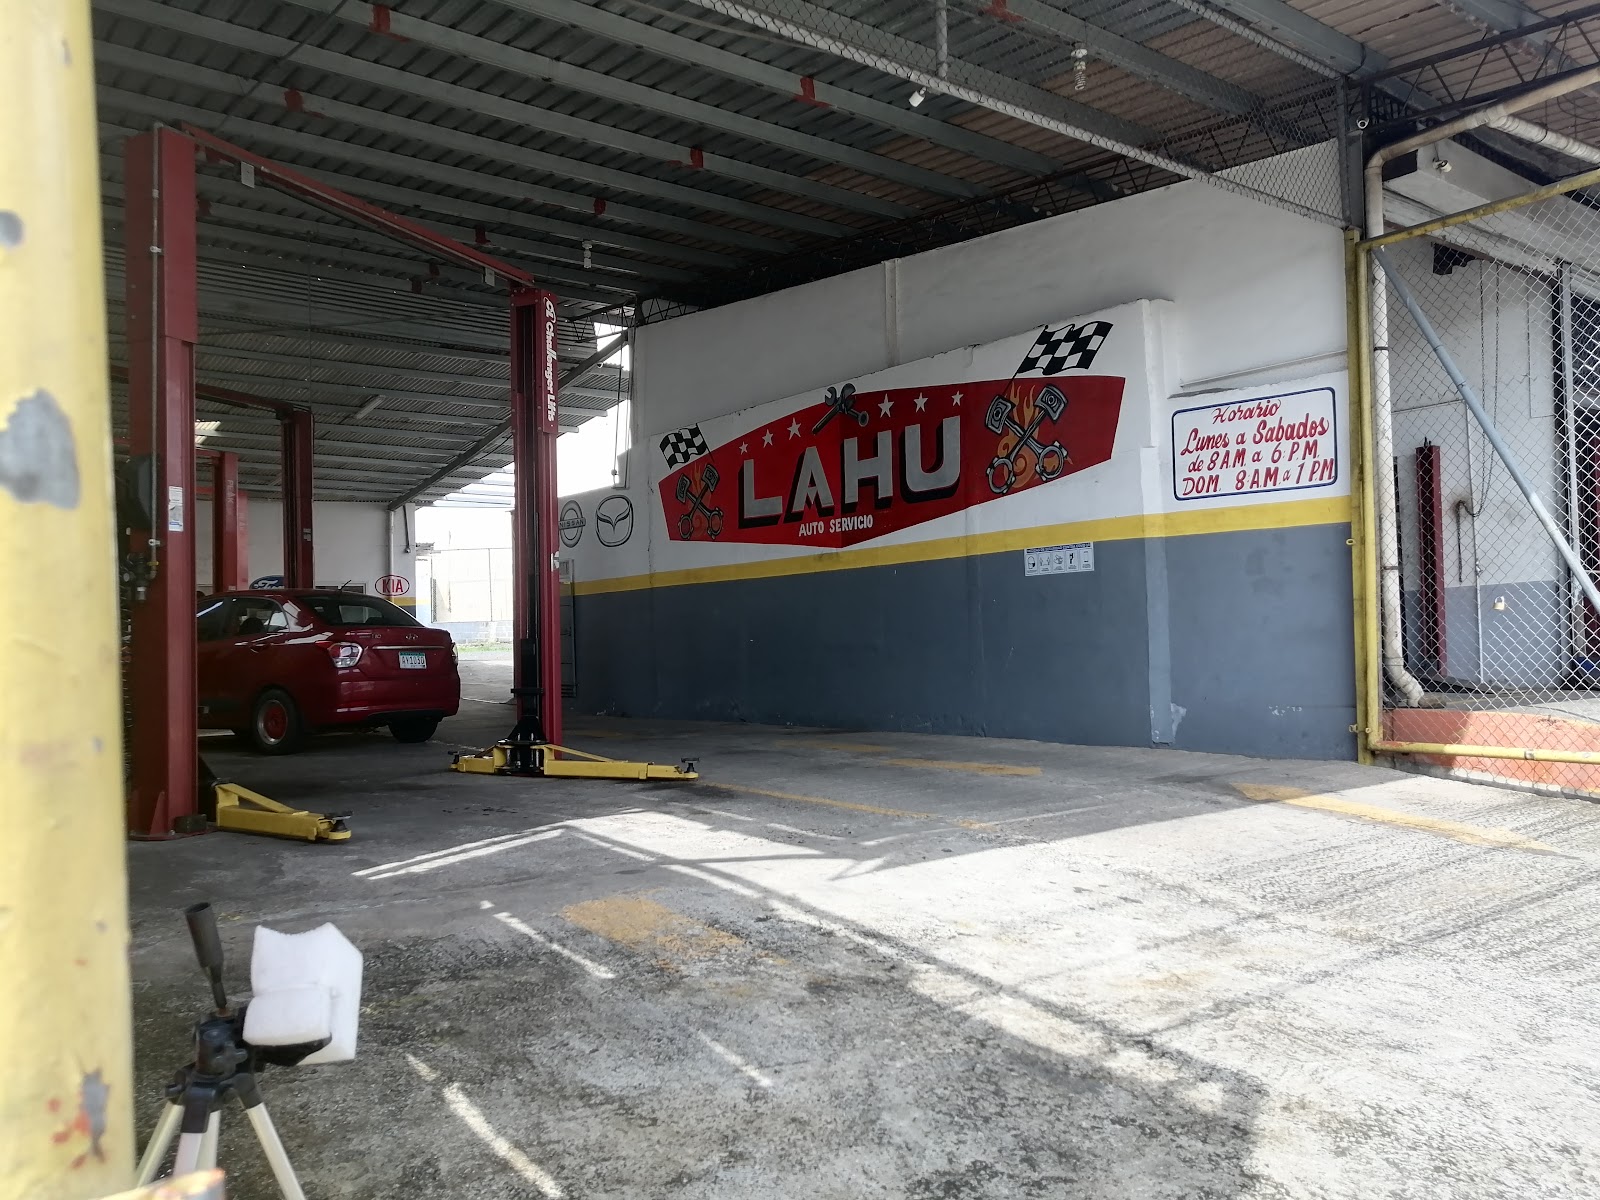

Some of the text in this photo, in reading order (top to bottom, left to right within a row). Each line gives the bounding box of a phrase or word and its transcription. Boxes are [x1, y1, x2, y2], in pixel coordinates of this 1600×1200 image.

[545, 322, 557, 394] Challenger
[547, 394, 557, 421] Lifts
[1211, 399, 1282, 424] Horario
[1180, 413, 1330, 456] Lunes a Sabados
[741, 415, 962, 524] LAHU
[1187, 455, 1204, 473] de
[1251, 449, 1264, 463] a
[1282, 468, 1292, 482] a
[226, 479, 236, 503] PEAK
[560, 519, 584, 528] NISSAN
[799, 514, 874, 537] AUTO SERVICIO
[382, 578, 404, 593] KIA
